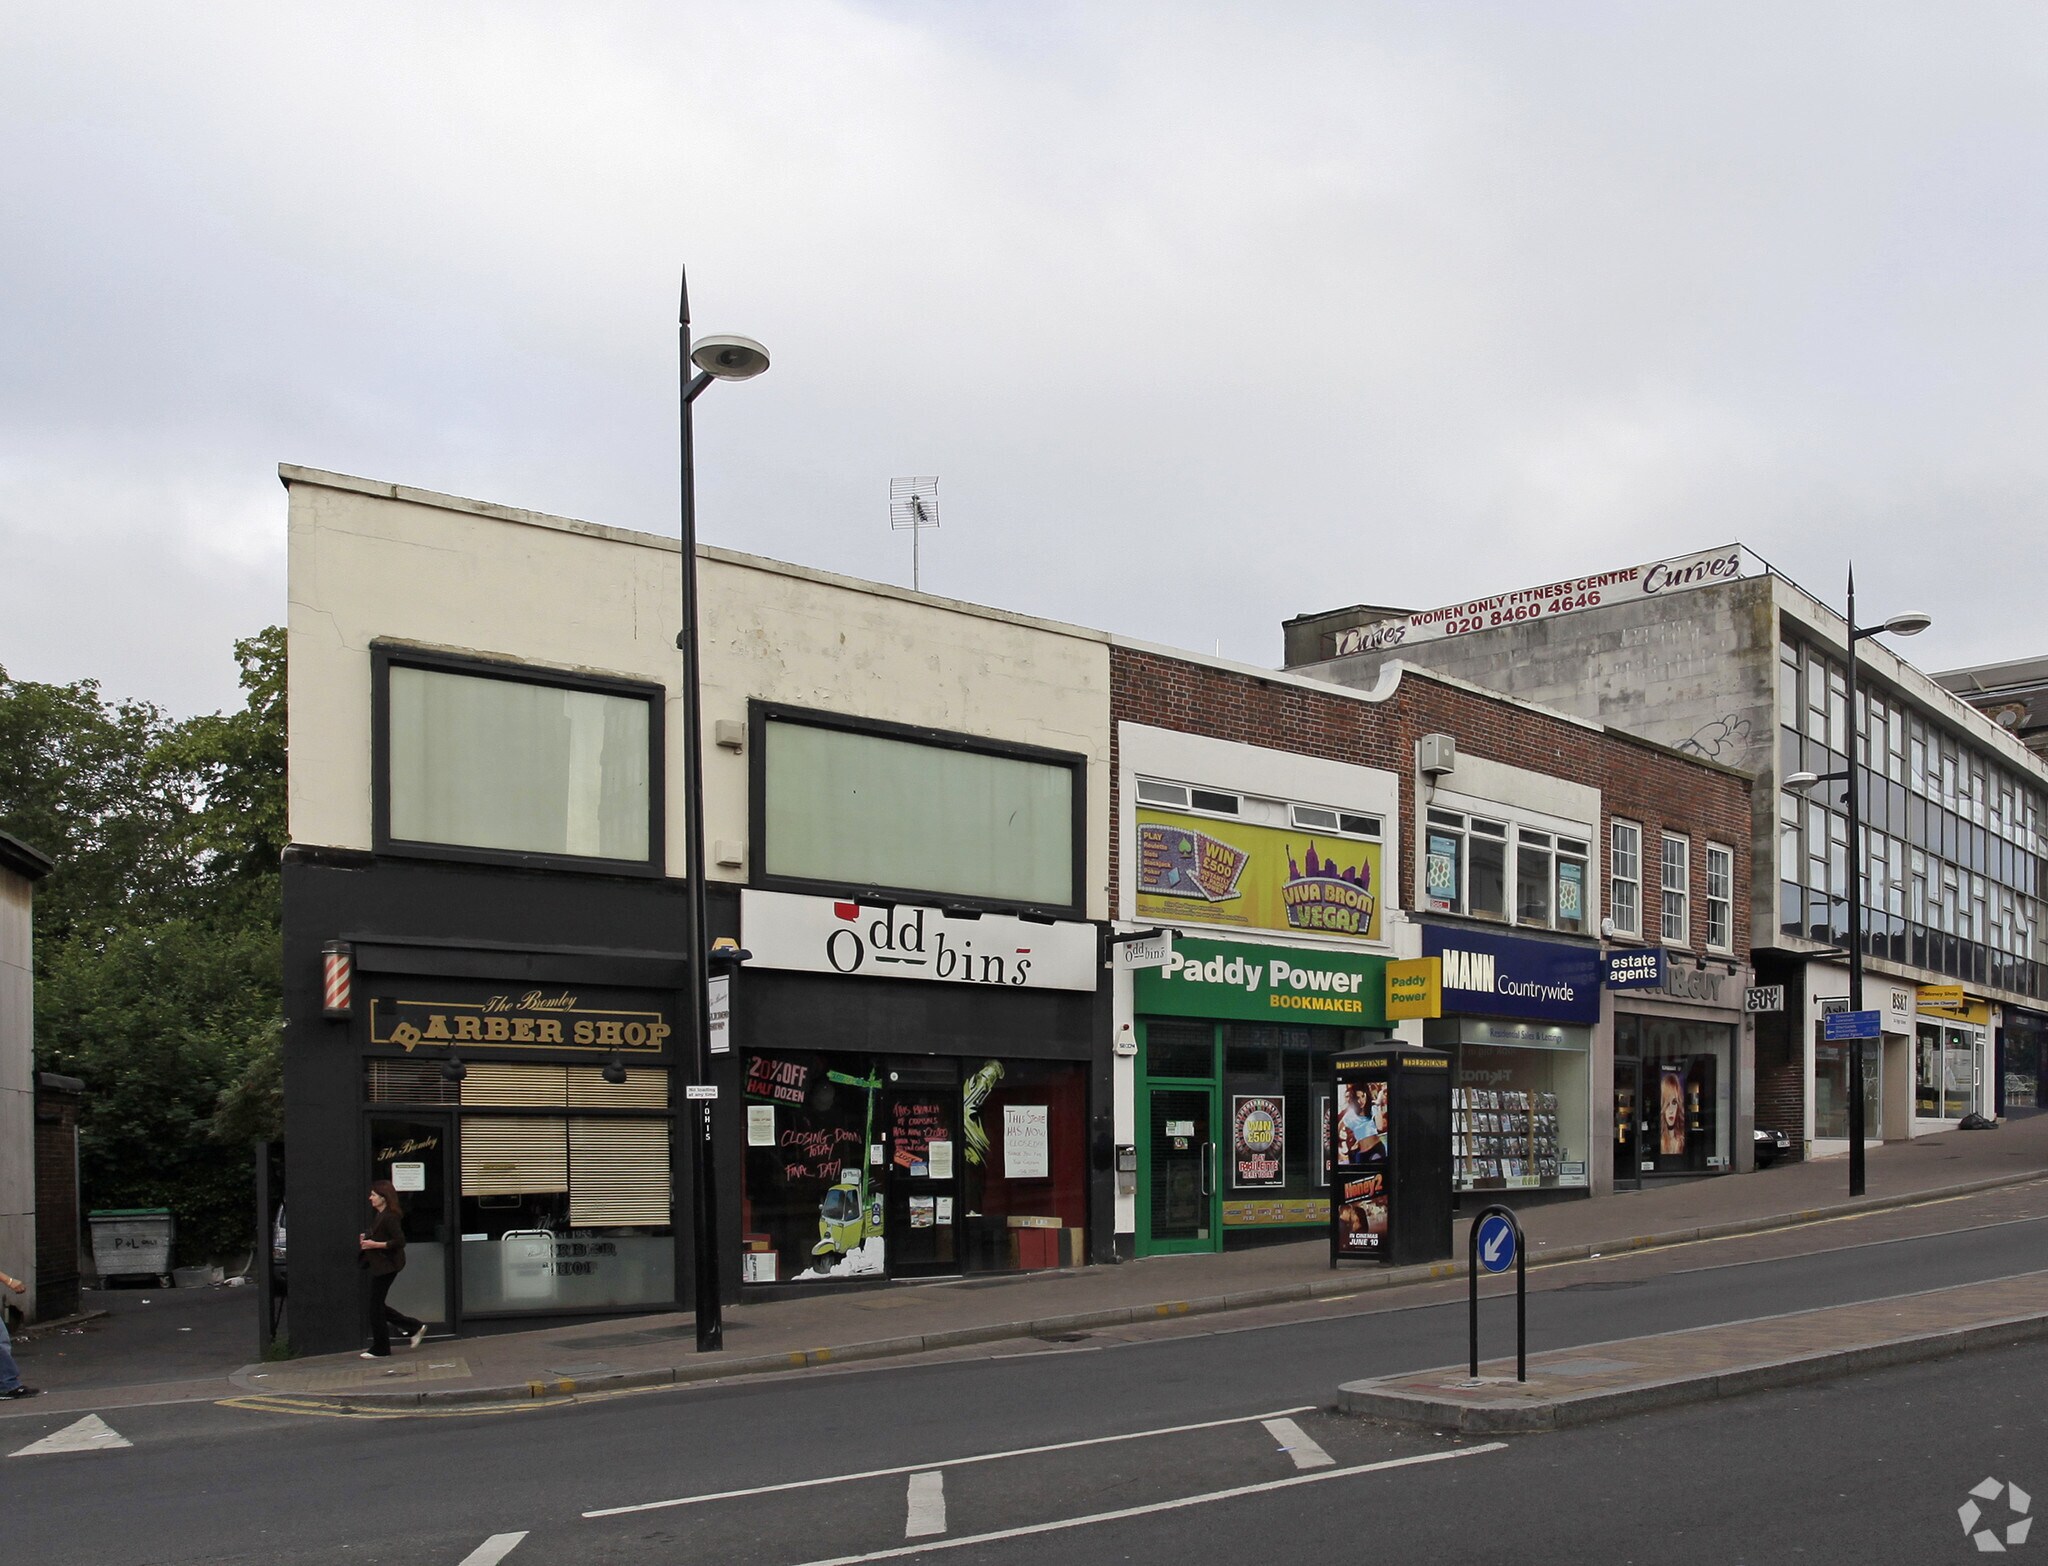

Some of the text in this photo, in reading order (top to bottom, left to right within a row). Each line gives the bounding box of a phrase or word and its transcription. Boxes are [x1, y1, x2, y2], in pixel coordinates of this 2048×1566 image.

[1643, 552, 1740, 594] Curves
[1411, 568, 1638, 627] WOMEN ONLY FITNESS CENTRE
[1446, 591, 1601, 635] 020 8460 4646
[1340, 621, 1405, 655] Curves
[1143, 832, 1163, 841] PLAY
[1206, 841, 1235, 867] WIN
[1203, 857, 1232, 878] £500
[1283, 883, 1373, 915] VIVA BROM
[1296, 905, 1360, 934] VEGAS
[826, 907, 1032, 986] Oddbins
[1611, 955, 1656, 969] estate
[1162, 951, 1363, 994] Paddy Power
[1391, 975, 1426, 989] Paddy
[1442, 949, 1575, 1003] MANN Countrywide
[1610, 967, 1658, 983] agents
[482, 990, 578, 1013] The Bromley
[1270, 994, 1363, 1013] BOOKMAKER
[1391, 990, 1427, 1004] Power
[1747, 998, 1777, 1010] GUY
[390, 1015, 671, 1053] BARBER SHOP
[1338, 1059, 1385, 1069] TELEPHONE
[1404, 1059, 1446, 1067] TELEPHONE
[747, 1079, 805, 1103] HALF DOZEN
[1006, 1110, 1025, 1124] THIS
[1247, 1121, 1271, 1131] WIN
[780, 1128, 833, 1147] CLOSING
[1007, 1126, 1046, 1137] HAS NOW
[1247, 1131, 1271, 1143] £500
[1344, 1179, 1375, 1199] Honey
